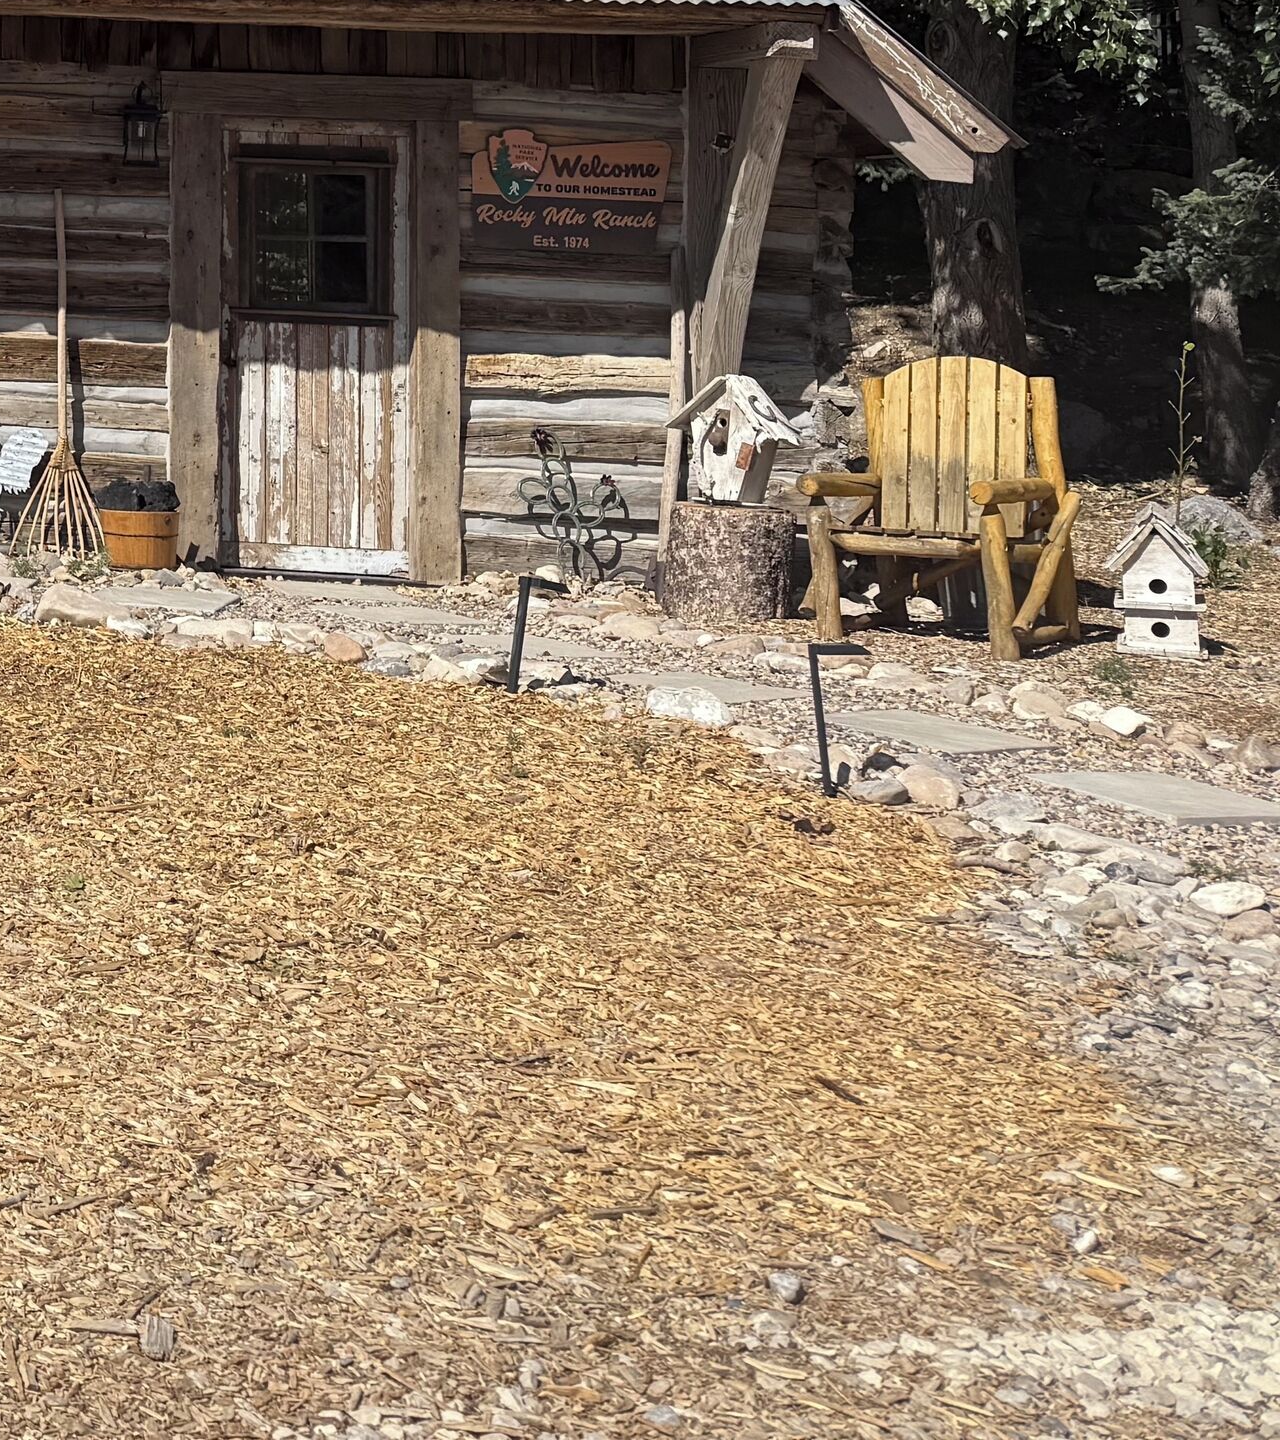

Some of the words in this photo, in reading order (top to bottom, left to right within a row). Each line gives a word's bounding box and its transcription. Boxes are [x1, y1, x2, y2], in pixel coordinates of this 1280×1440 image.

[550, 155, 660, 178] Welcome
[536, 184, 552, 192] TO
[556, 184, 580, 194] OUR
[584, 185, 657, 197] HOMESTEAD
[476, 204, 536, 228] Rocky
[543, 207, 587, 226] Mtn
[593, 209, 656, 230] Ranch
[533, 235, 558, 247] Est.
[563, 237, 589, 248] 1974
